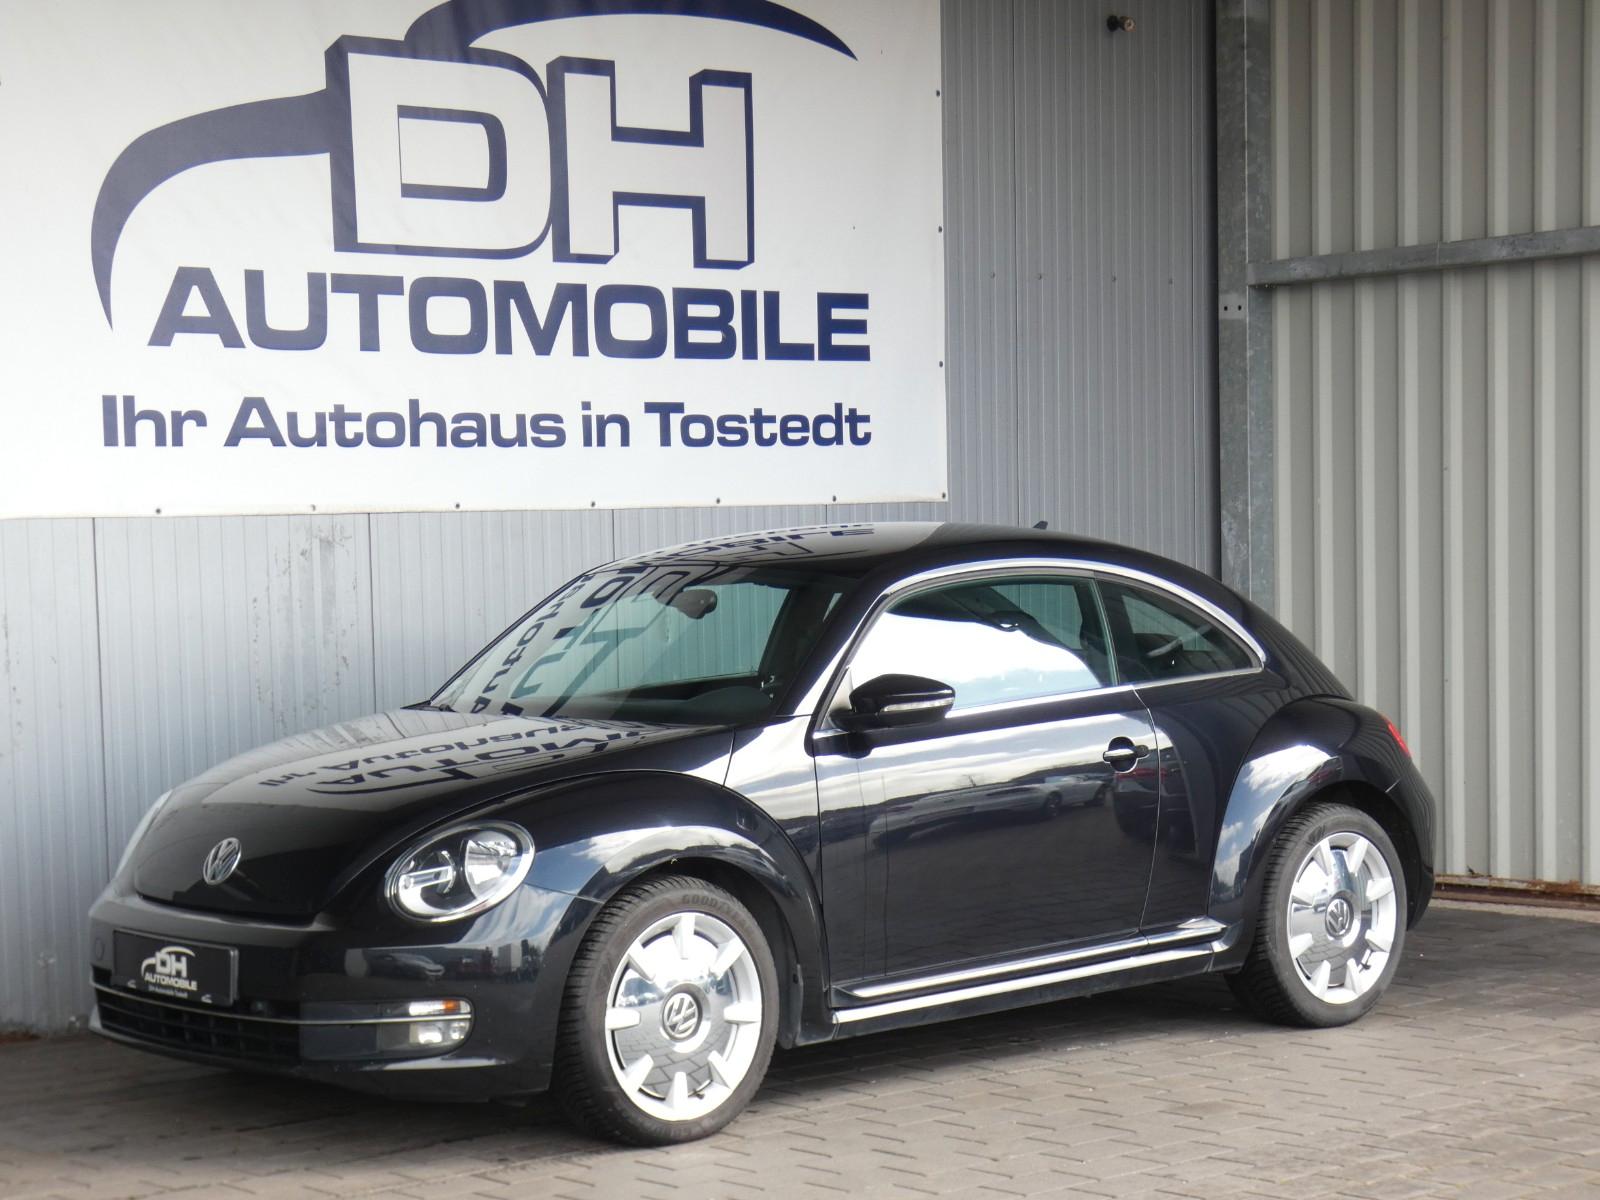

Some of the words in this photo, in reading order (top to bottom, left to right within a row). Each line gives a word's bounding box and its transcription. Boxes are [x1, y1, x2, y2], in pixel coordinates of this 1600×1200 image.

[325, 35, 754, 269] DH
[148, 267, 871, 361] AUTOMOBILE
[102, 395, 207, 447] Ihr
[223, 398, 567, 448] Autohaus
[581, 401, 630, 447] in
[644, 402, 872, 448] Tostedt
[144, 972, 198, 991] AUTOMOBILE
[155, 951, 188, 978] DH
